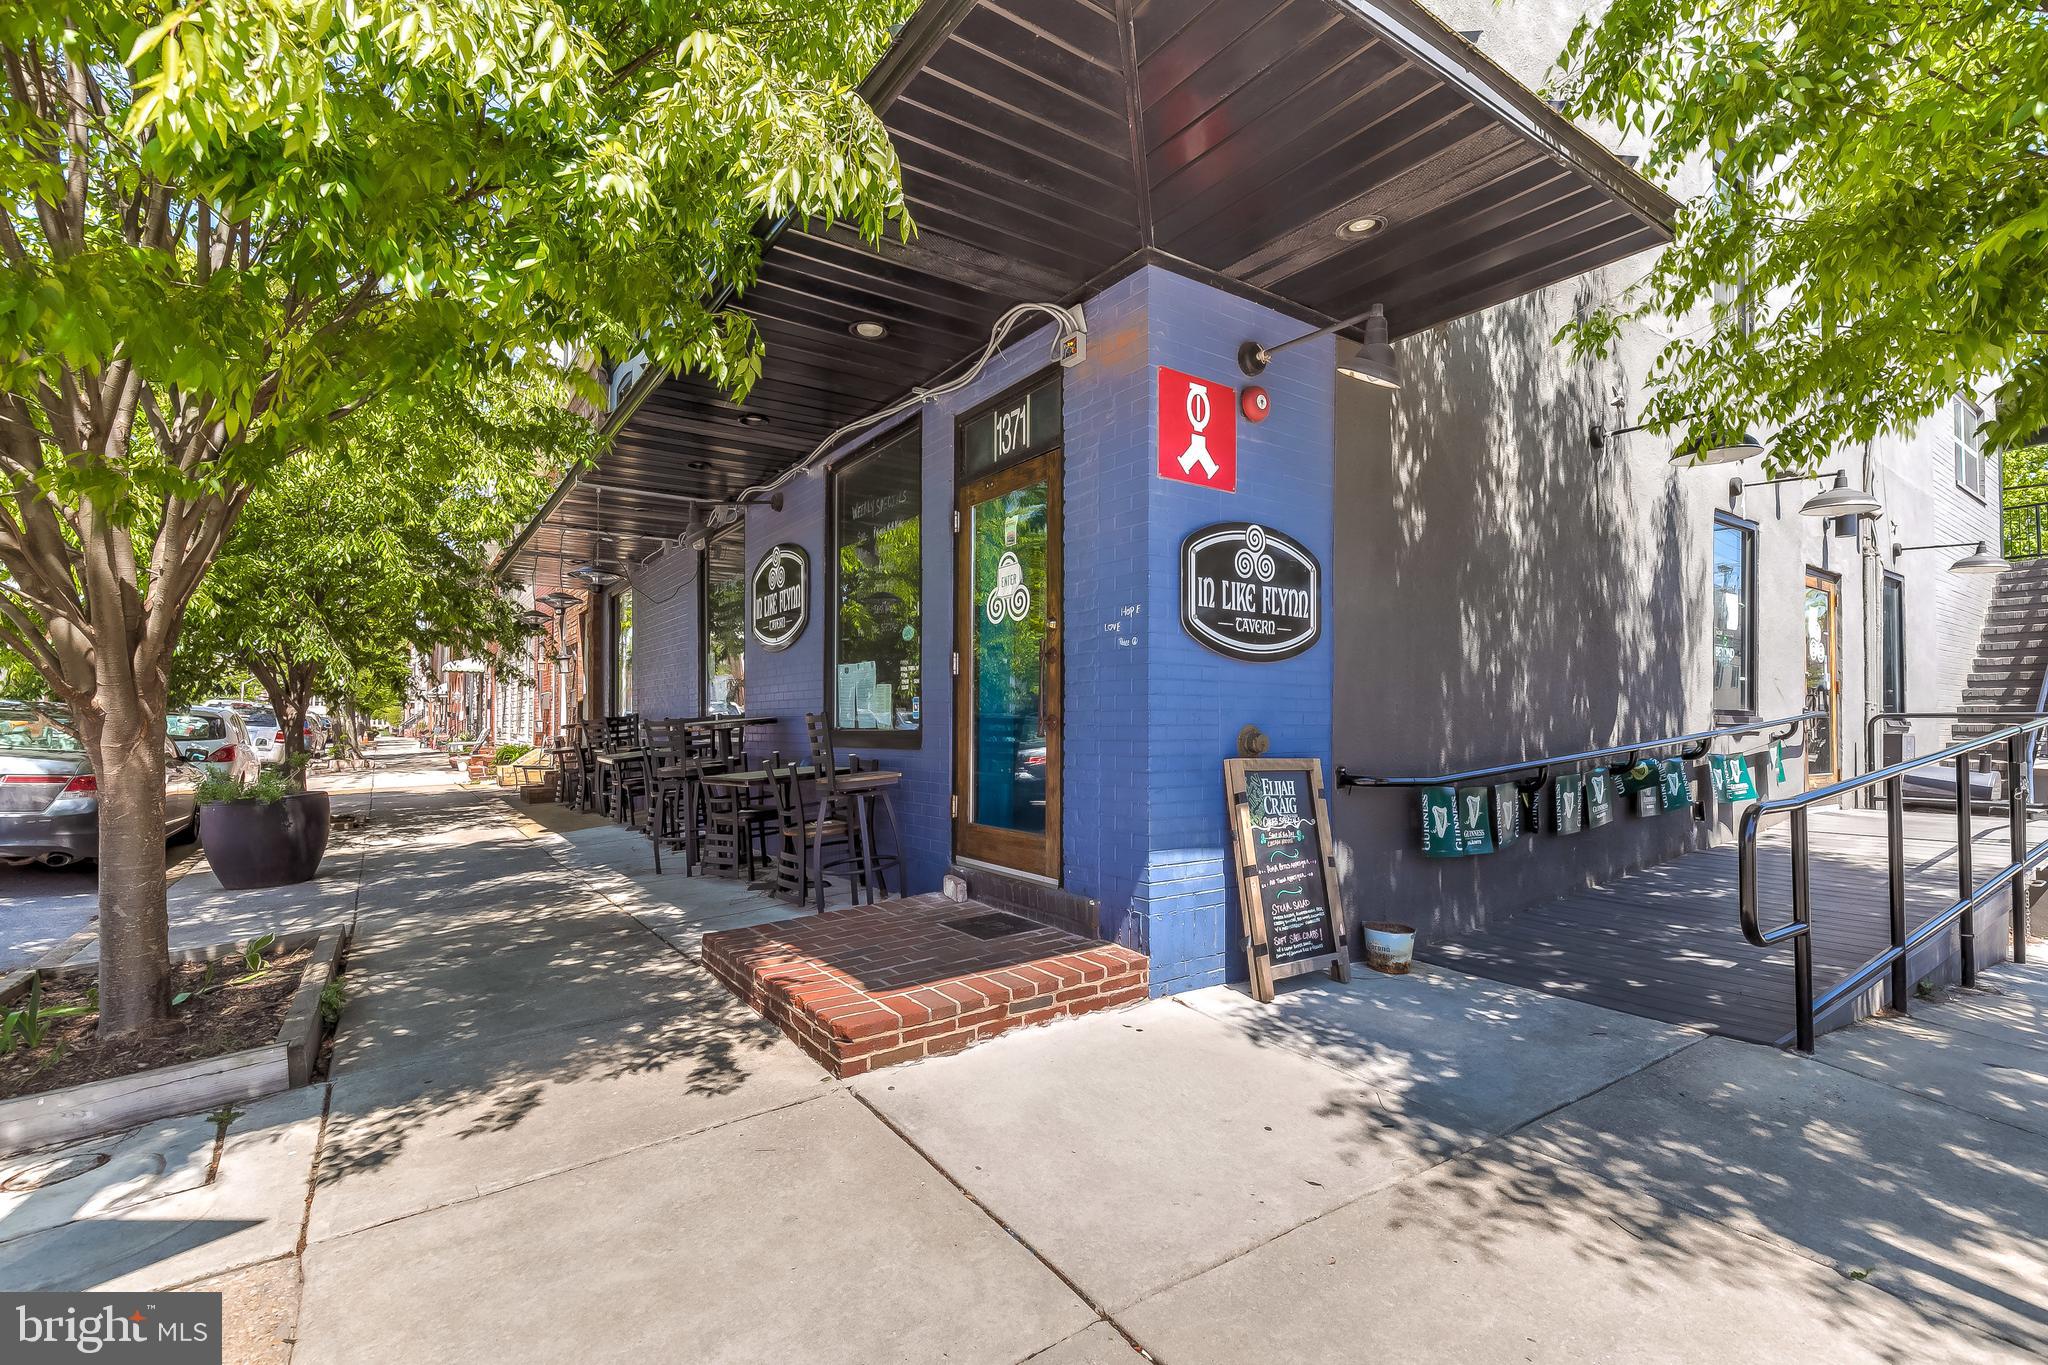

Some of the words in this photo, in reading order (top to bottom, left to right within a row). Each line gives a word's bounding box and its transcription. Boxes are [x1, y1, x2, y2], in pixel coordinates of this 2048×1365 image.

[997, 404, 1026, 456] 1371
[1001, 573, 1017, 588] ENTER
[764, 592, 777, 617] LIKE
[780, 584, 801, 613] FLYNN
[1198, 577, 1215, 608] IN
[1222, 580, 1256, 612] LIKE
[1262, 586, 1309, 618] FLYNN
[1104, 621, 1120, 632] LOVE
[1235, 618, 1275, 635] TAVERN
[1261, 778, 1296, 799] ELIJAH
[1264, 796, 1298, 816] CRAIG
[1422, 793, 1431, 851] GUINNESS
[1452, 795, 1463, 851] GUINNESS
